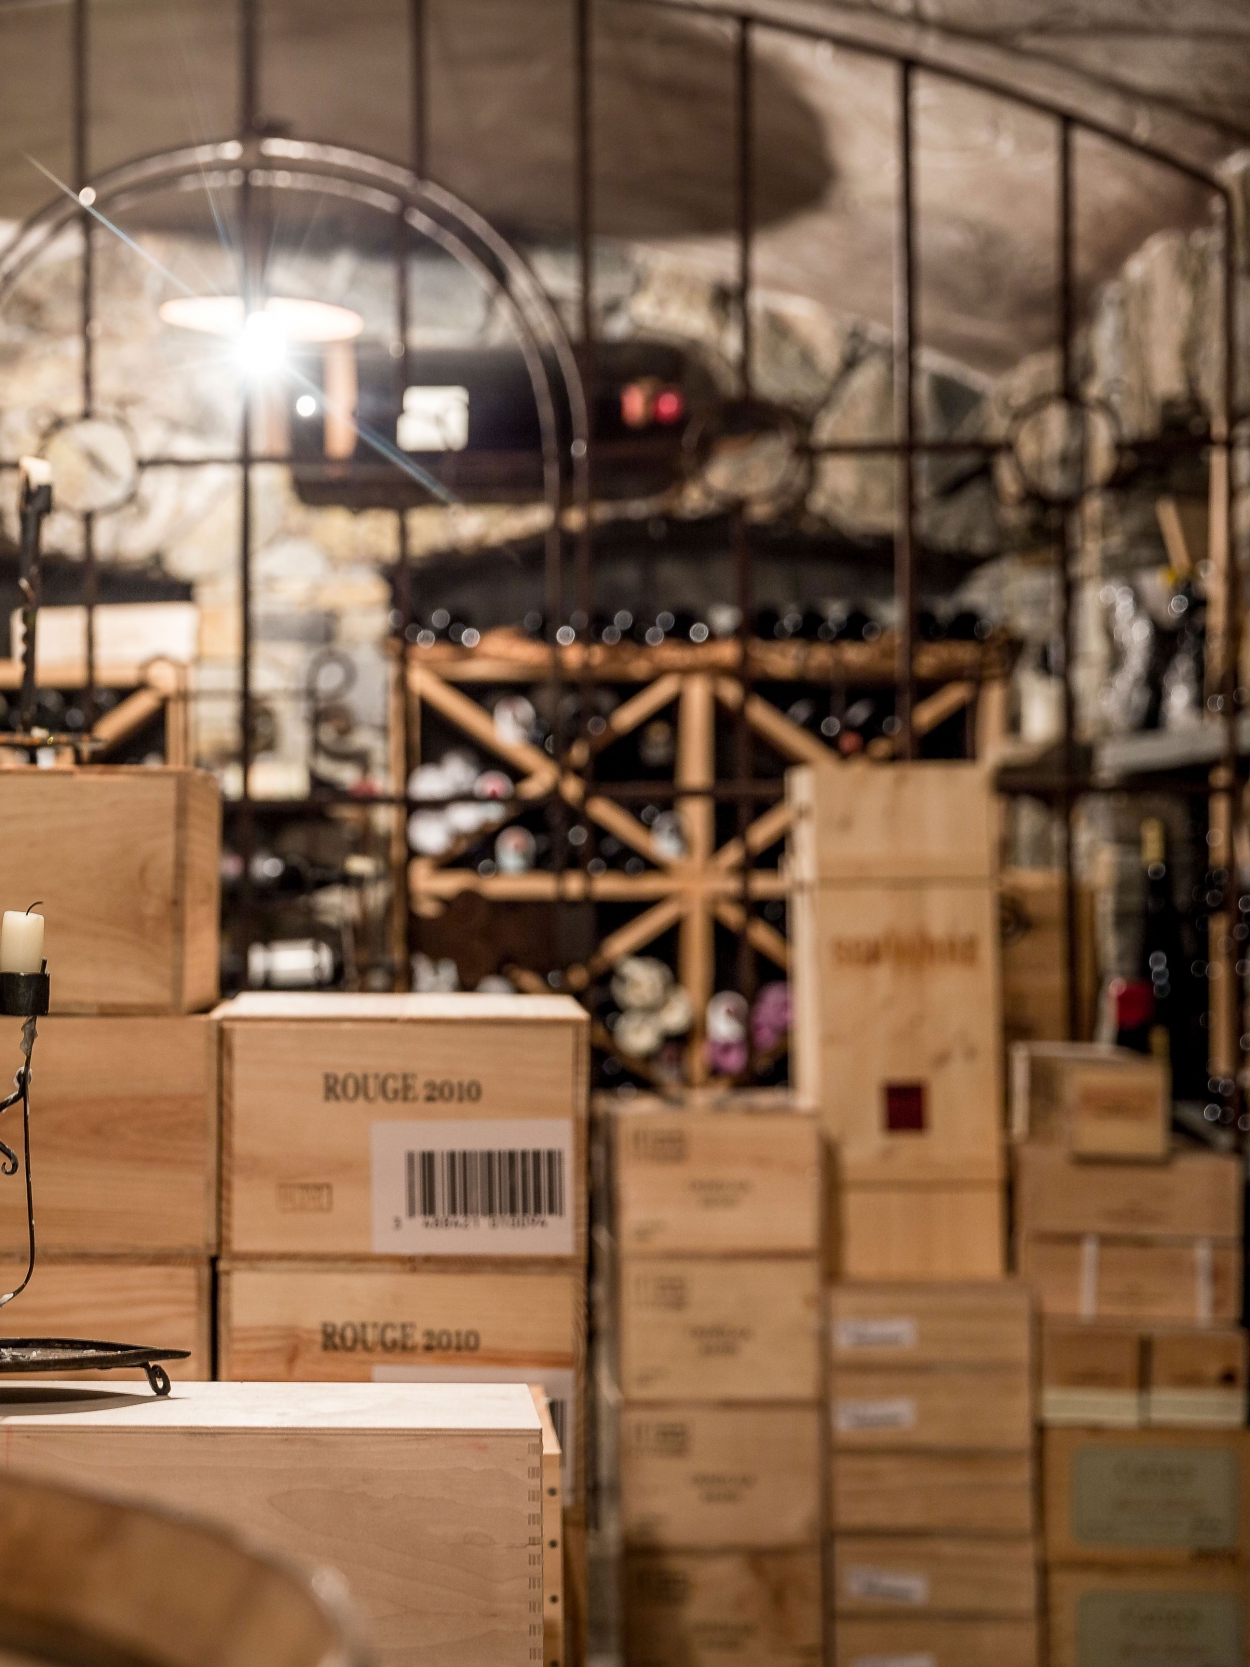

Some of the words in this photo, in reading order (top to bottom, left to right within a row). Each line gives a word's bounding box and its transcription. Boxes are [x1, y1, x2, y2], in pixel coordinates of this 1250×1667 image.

[322, 1071, 419, 1103] ROUGE
[423, 1079, 483, 1103] 2010
[321, 1320, 417, 1353] ROUGE
[422, 1329, 481, 1353] 2010
